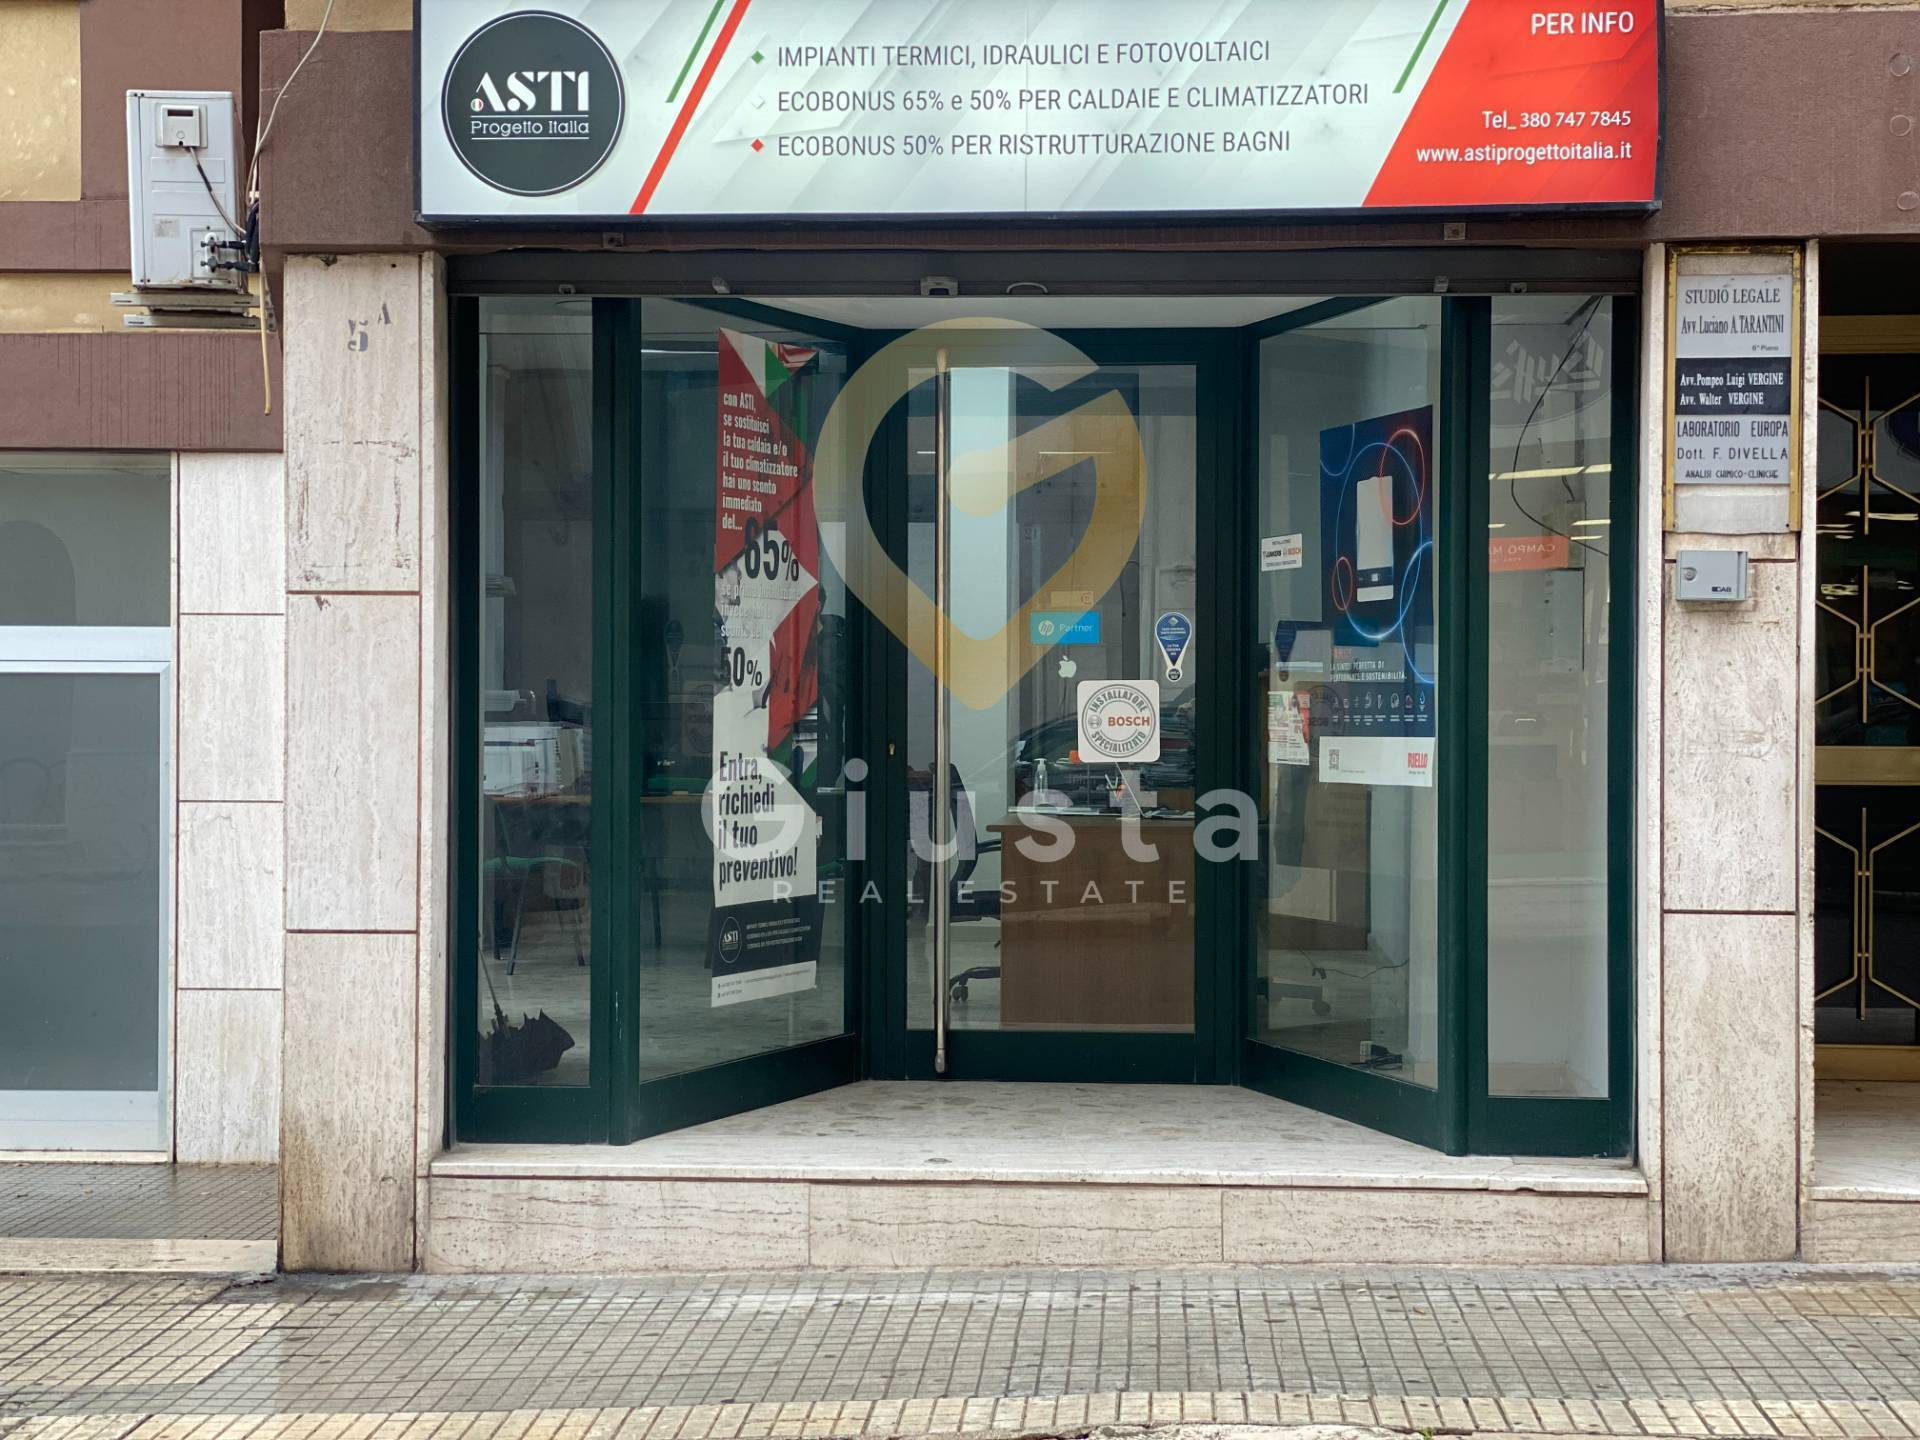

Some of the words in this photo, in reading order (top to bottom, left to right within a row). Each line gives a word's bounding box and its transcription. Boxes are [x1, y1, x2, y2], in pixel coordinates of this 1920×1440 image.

[1531, 13, 1574, 35] PER
[1581, 11, 1634, 34] INFO
[778, 46, 875, 67] IMPIANTI
[882, 45, 976, 69] TERMICI,
[983, 44, 1089, 66] IDRAULICI
[1097, 43, 1110, 64] E
[1116, 41, 1270, 64] FOTOVOLTAICI
[471, 71, 590, 112] ASTI
[778, 91, 896, 112] ECOBONUS
[902, 90, 944, 111] 65%
[951, 95, 963, 110] e
[969, 89, 1012, 110] 50%
[1018, 89, 1061, 110] PER
[1067, 88, 1161, 110] CALDAIE
[1167, 87, 1180, 108] E
[1186, 84, 1368, 108] CLIMATIZZATORI
[470, 120, 543, 136] Progetto
[548, 119, 589, 135] Italia
[1519, 112, 1551, 128] 380
[1555, 112, 1586, 127] 747
[1590, 111, 1632, 127] 7845
[778, 136, 896, 157] ECOBONUS
[903, 135, 944, 156] 50%
[951, 135, 992, 155] PER
[999, 132, 1216, 155] RISTRUTTURAZIONE
[1223, 131, 1290, 153] BAGNI
[1416, 141, 1632, 165] www.astiprogettoitalia.it
[1685, 289, 1729, 304] STUDIO
[1733, 288, 1781, 304] LEGALE
[1726, 373, 1745, 388] Luigi
[1748, 372, 1784, 385] VERGINE
[723, 392, 738, 406] con
[739, 393, 757, 413] ASTI,
[1680, 393, 1696, 406] Avv.
[1699, 392, 1722, 406] Walter
[1728, 392, 1764, 405] VERGINE
[723, 415, 732, 427] se
[734, 413, 770, 435] sostituisci
[1677, 420, 1740, 438] LABORATORIO
[1751, 420, 1788, 438] EUROPA
[723, 430, 731, 448] la
[732, 434, 746, 449] tua
[747, 434, 772, 454] caldaia
[772, 439, 788, 457] e/o
[1728, 447, 1788, 460] DIVELLA
[722, 450, 729, 467] il
[730, 453, 744, 470] tuo
[745, 454, 799, 478] climatizzatore
[722, 471, 736, 489] hai
[737, 477, 751, 491] uno
[752, 478, 777, 495] sconto
[722, 492, 762, 513] immediato
[744, 516, 800, 582] 65%
[1059, 622, 1095, 634] Partner
[1089, 689, 1148, 713] INSTALLATORE
[1108, 716, 1151, 727] BOSCH
[1091, 731, 1147, 753] SPECIALIZZATO
[719, 751, 763, 784] Entra,
[718, 783, 775, 816] richiedi
[732, 820, 758, 849] tuo
[719, 846, 799, 891] preventivo!
